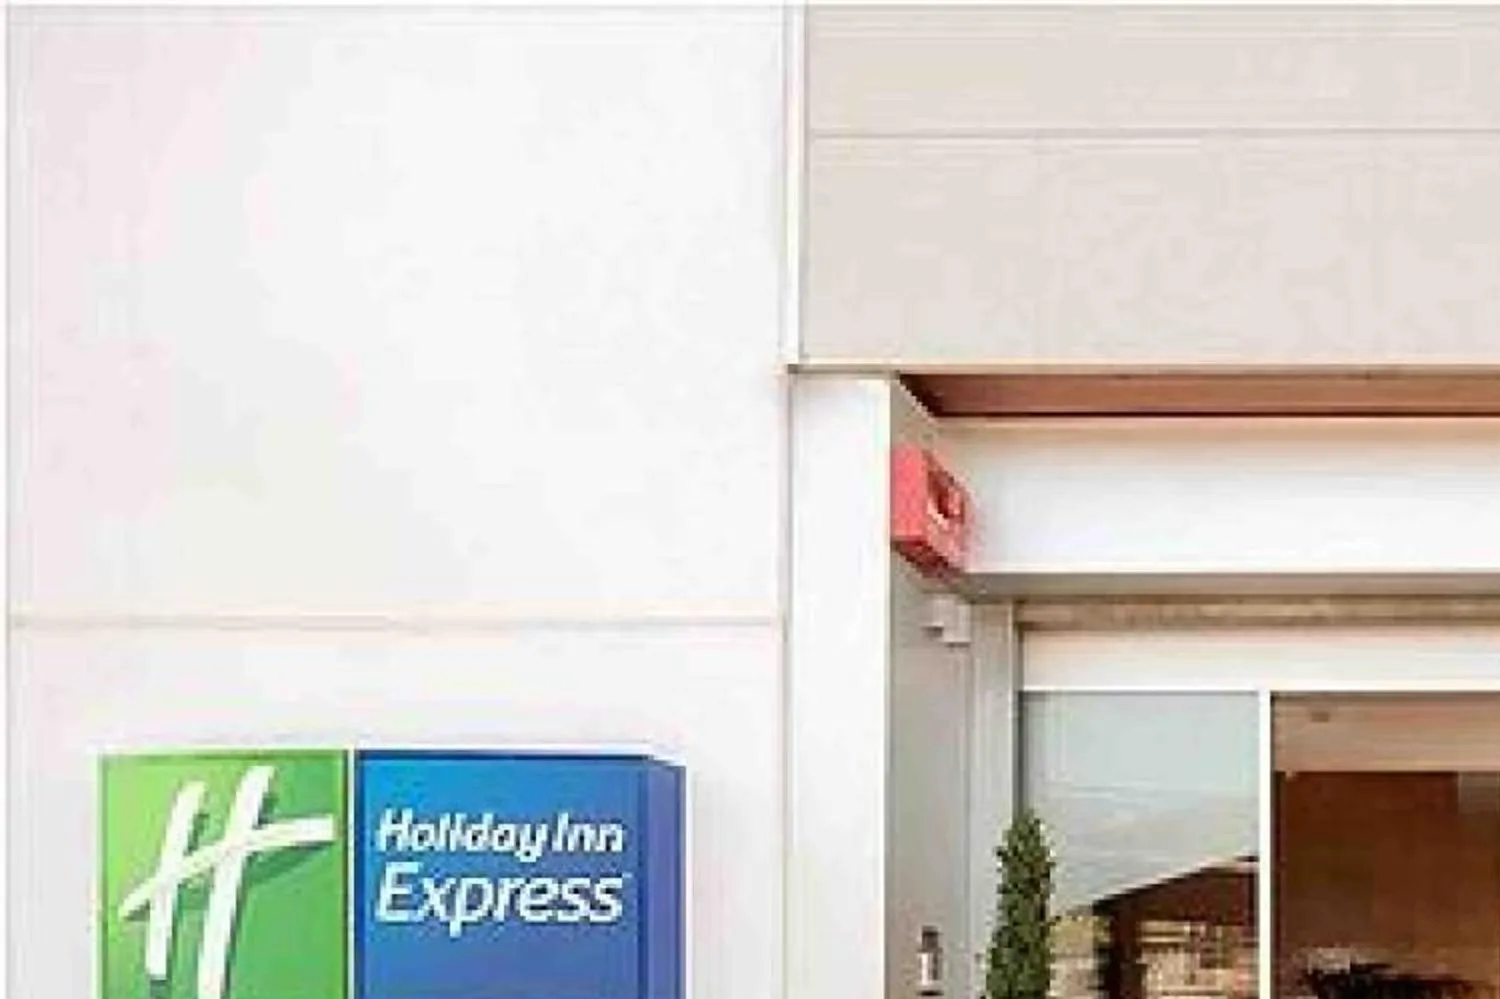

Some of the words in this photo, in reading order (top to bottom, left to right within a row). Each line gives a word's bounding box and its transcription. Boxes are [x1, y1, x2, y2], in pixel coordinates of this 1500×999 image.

[377, 808, 544, 862] Holiday
[553, 812, 624, 852] Inn
[375, 861, 624, 936] Express
